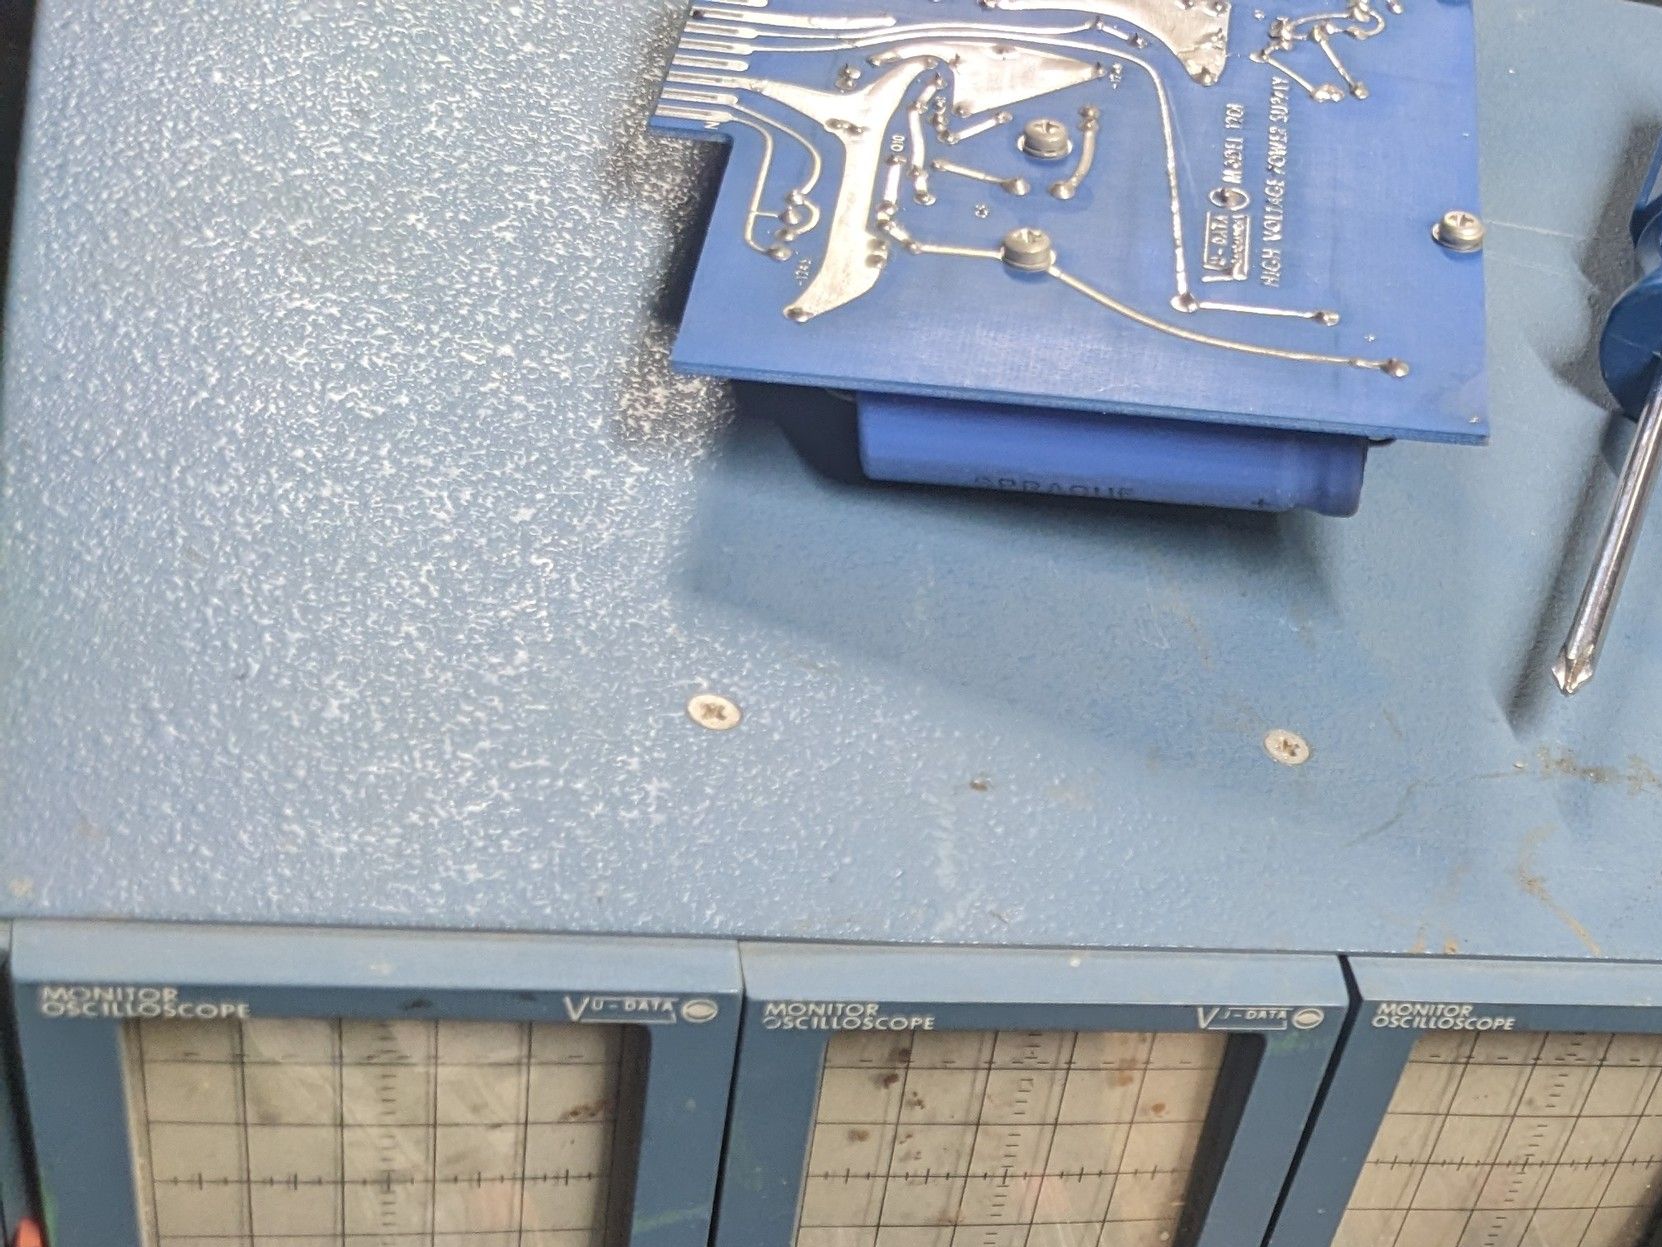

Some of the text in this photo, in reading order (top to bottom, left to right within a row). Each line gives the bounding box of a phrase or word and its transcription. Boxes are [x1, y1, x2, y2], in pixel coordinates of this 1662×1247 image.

[1263, 179, 1285, 242] VOLTAGE
[42, 986, 178, 1002] MONITOR
[41, 1001, 250, 1018] OSCILLOSCOPE
[764, 1003, 878, 1017] MONITOR
[1377, 1002, 1473, 1016] MONITOR
[762, 1015, 935, 1031] OSCILLOSCOPE
[1371, 1015, 1516, 1031] OSCILLOSCOPE
